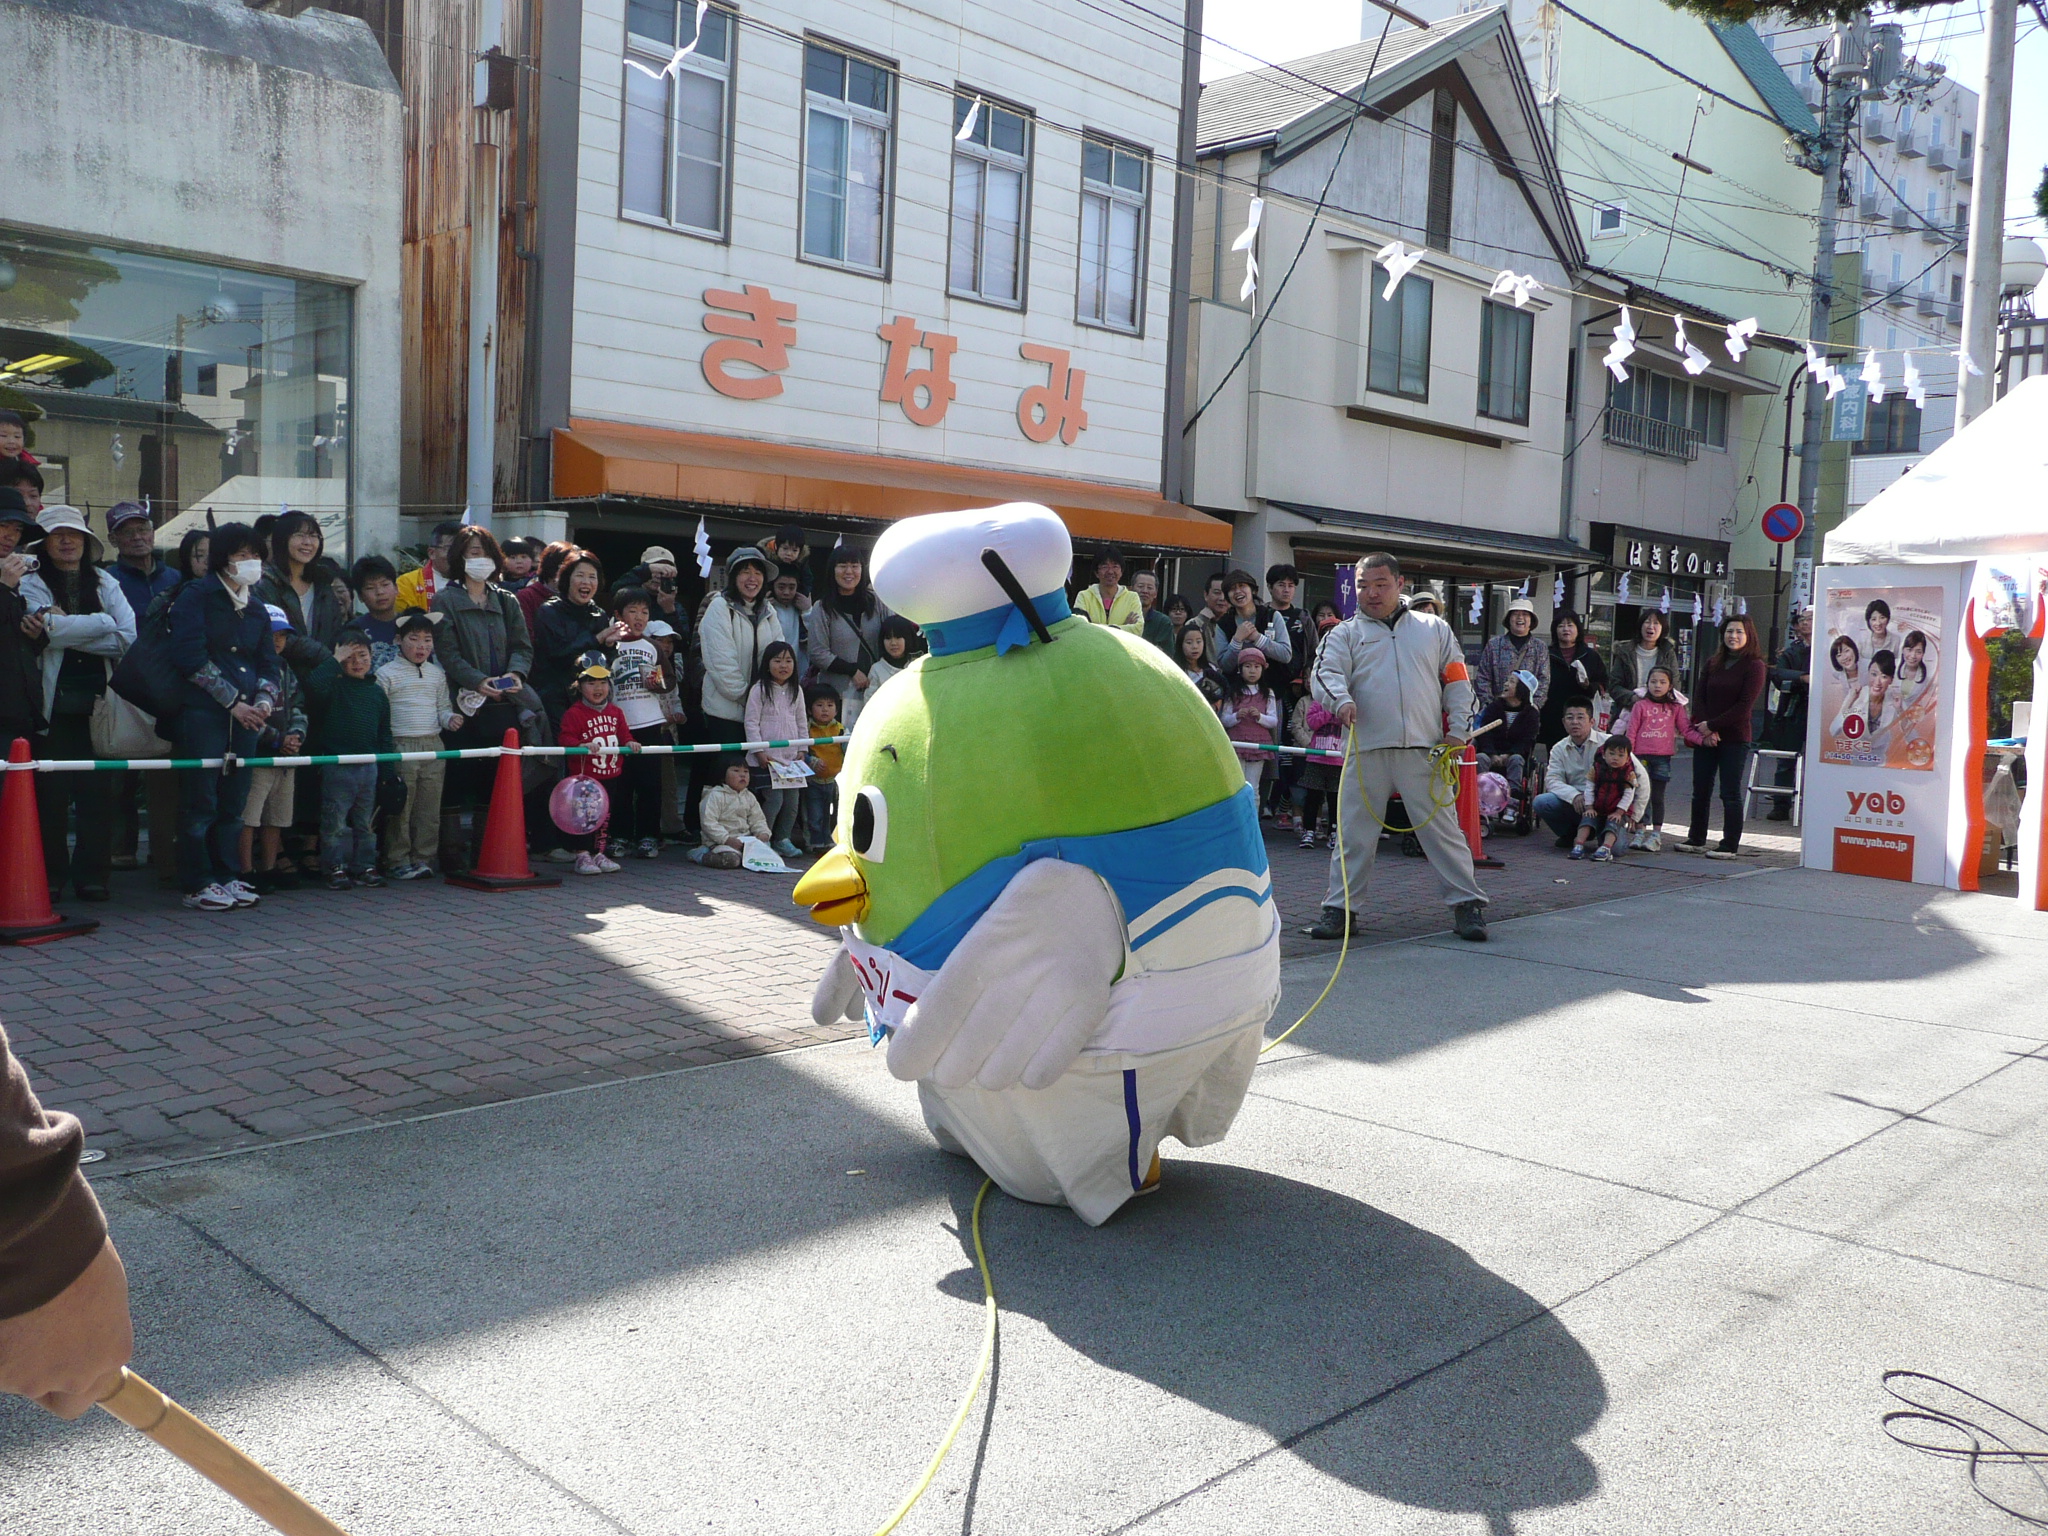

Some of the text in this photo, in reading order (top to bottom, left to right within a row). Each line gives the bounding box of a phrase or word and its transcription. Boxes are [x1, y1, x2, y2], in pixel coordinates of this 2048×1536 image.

[701, 284, 1088, 446] きなみ
[1629, 540, 1725, 577] はきもの 山本
[1846, 790, 1905, 815] yab
[1840, 834, 1908, 852] www.yab.co.jp
